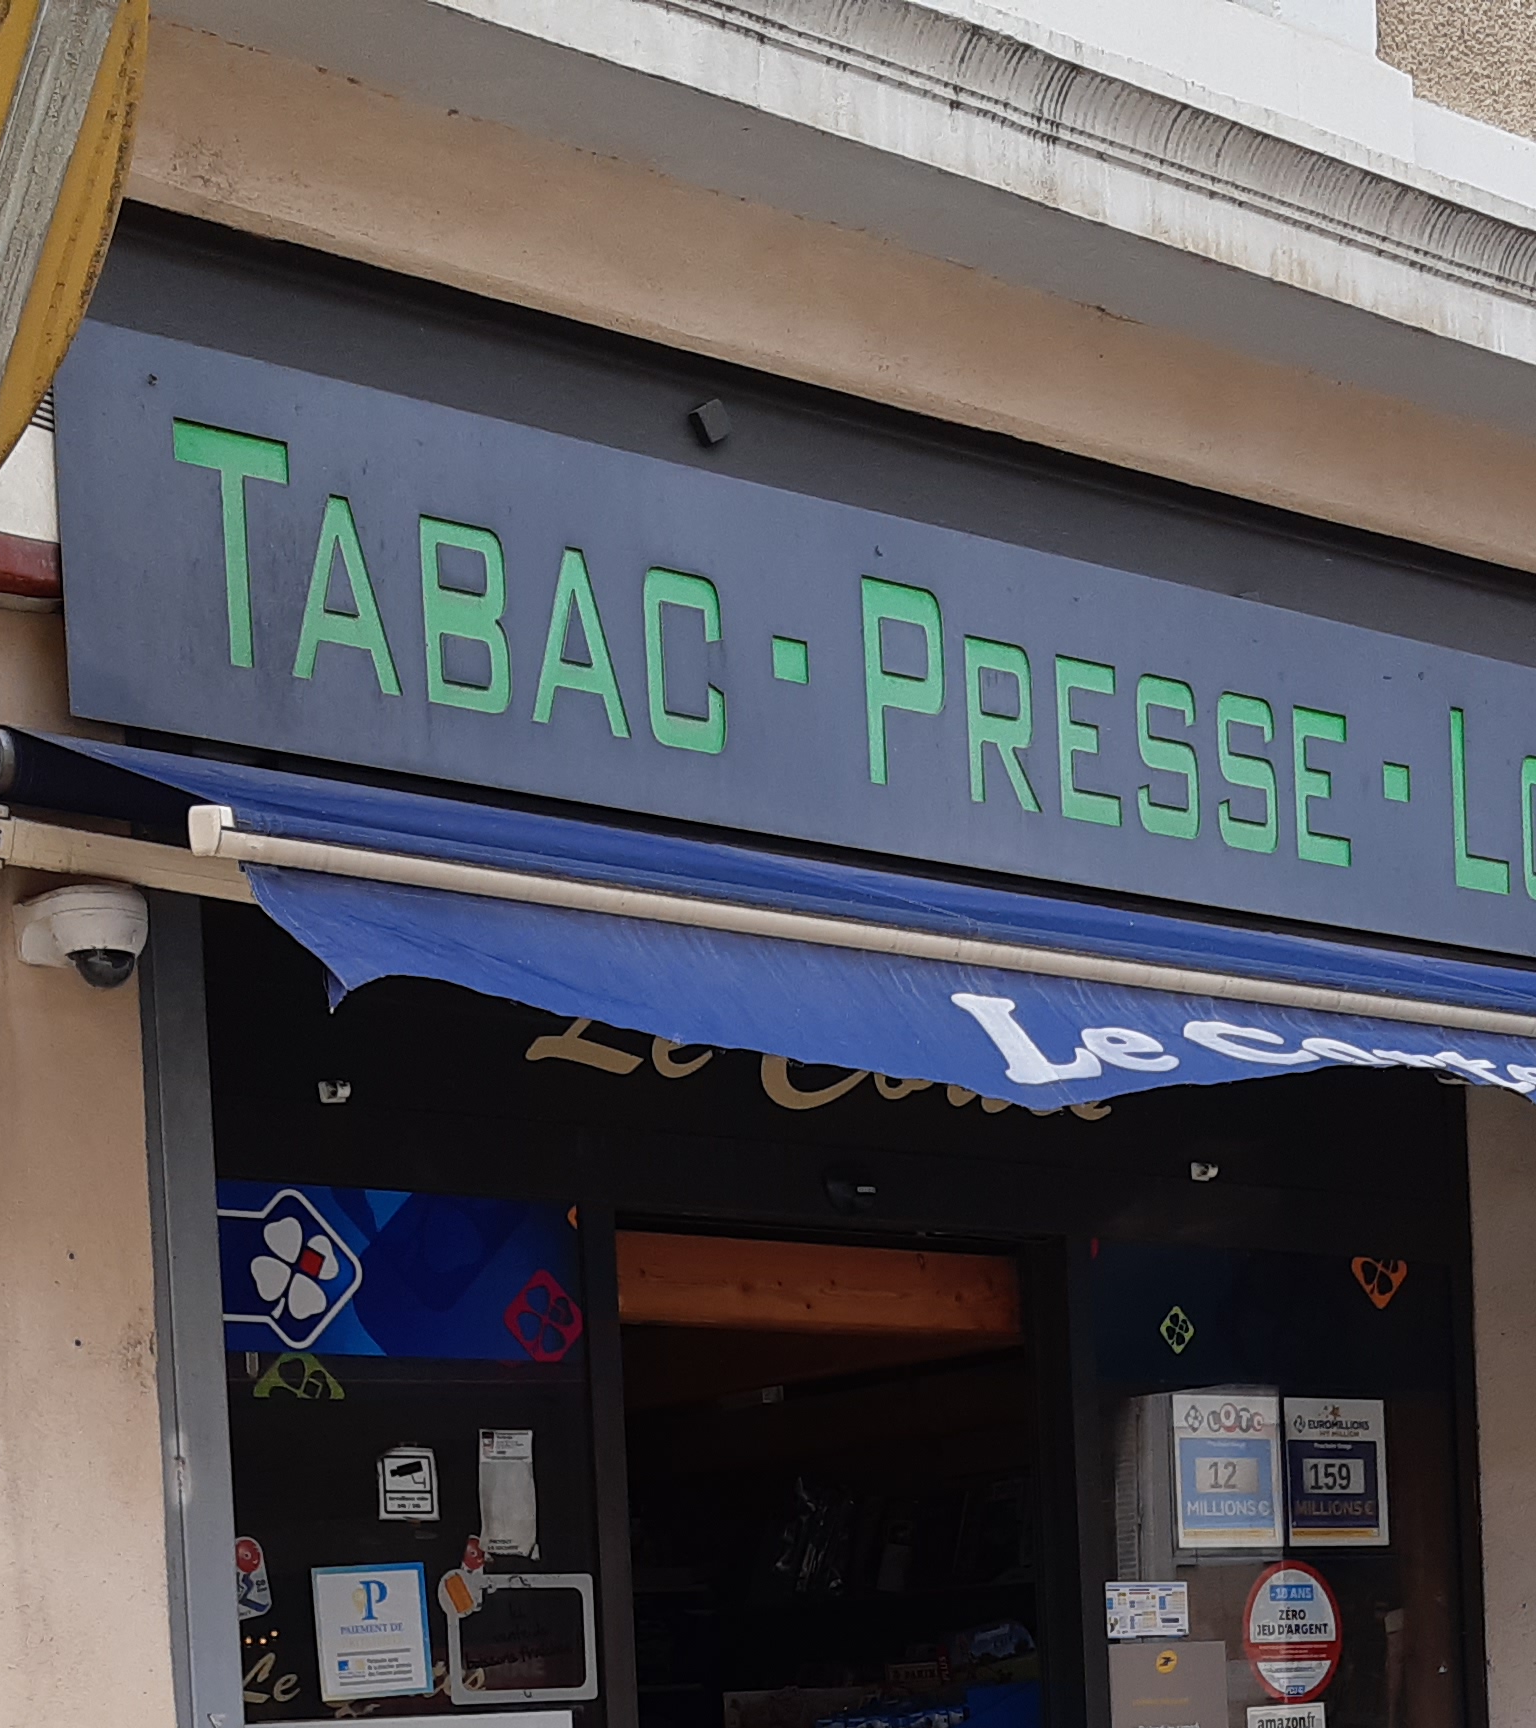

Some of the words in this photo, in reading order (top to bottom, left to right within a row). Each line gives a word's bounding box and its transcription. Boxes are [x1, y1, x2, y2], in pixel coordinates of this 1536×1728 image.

[173, 417, 727, 755] TABAC
[861, 575, 1352, 867] PRESSE
[950, 992, 1180, 1086] Le
[1308, 1420, 1369, 1430] EUROMILLIONS
[1209, 1461, 1237, 1489] 12
[1309, 1463, 1351, 1490] 159
[1187, 1500, 1254, 1516] MILLIONS
[1296, 1500, 1361, 1516] MILLIONS
[1290, 1587, 1312, 1600] ANS
[1278, 1607, 1306, 1620] ZÉRO
[1257, 1625, 1275, 1636] JEU
[1278, 1623, 1328, 1636] D'ARGENT
